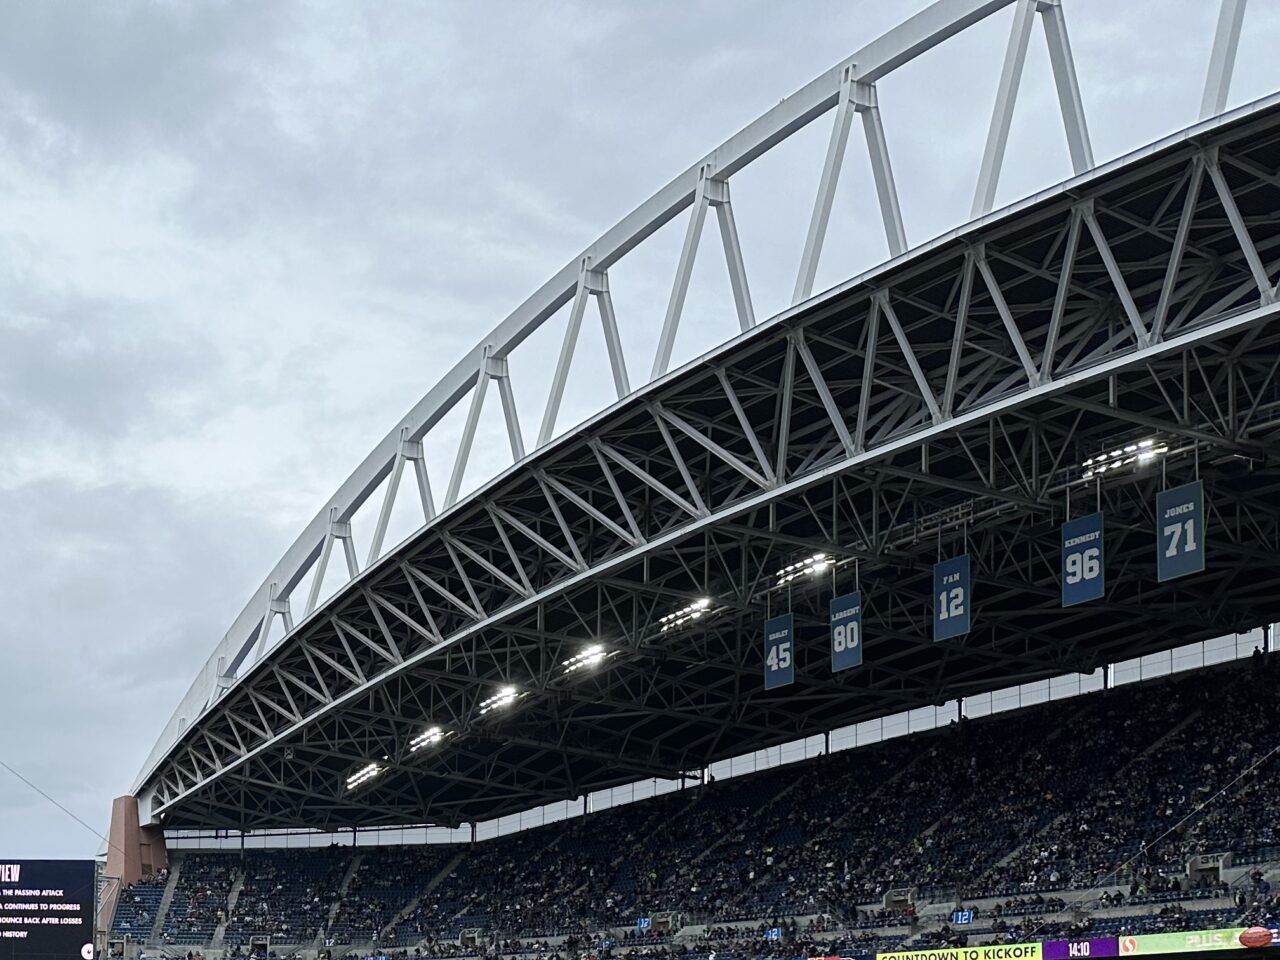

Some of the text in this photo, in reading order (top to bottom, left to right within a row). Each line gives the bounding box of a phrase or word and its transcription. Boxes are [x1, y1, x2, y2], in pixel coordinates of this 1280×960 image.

[1165, 502, 1194, 518] JONES
[1065, 531, 1100, 548] KENNEDY
[1164, 519, 1196, 558] 71
[943, 573, 960, 584] FAN
[1066, 548, 1099, 584] 96
[939, 587, 964, 620] 12
[834, 621, 858, 652] 80
[767, 642, 790, 671] 45
[1068, 941, 1090, 958] 14:10
